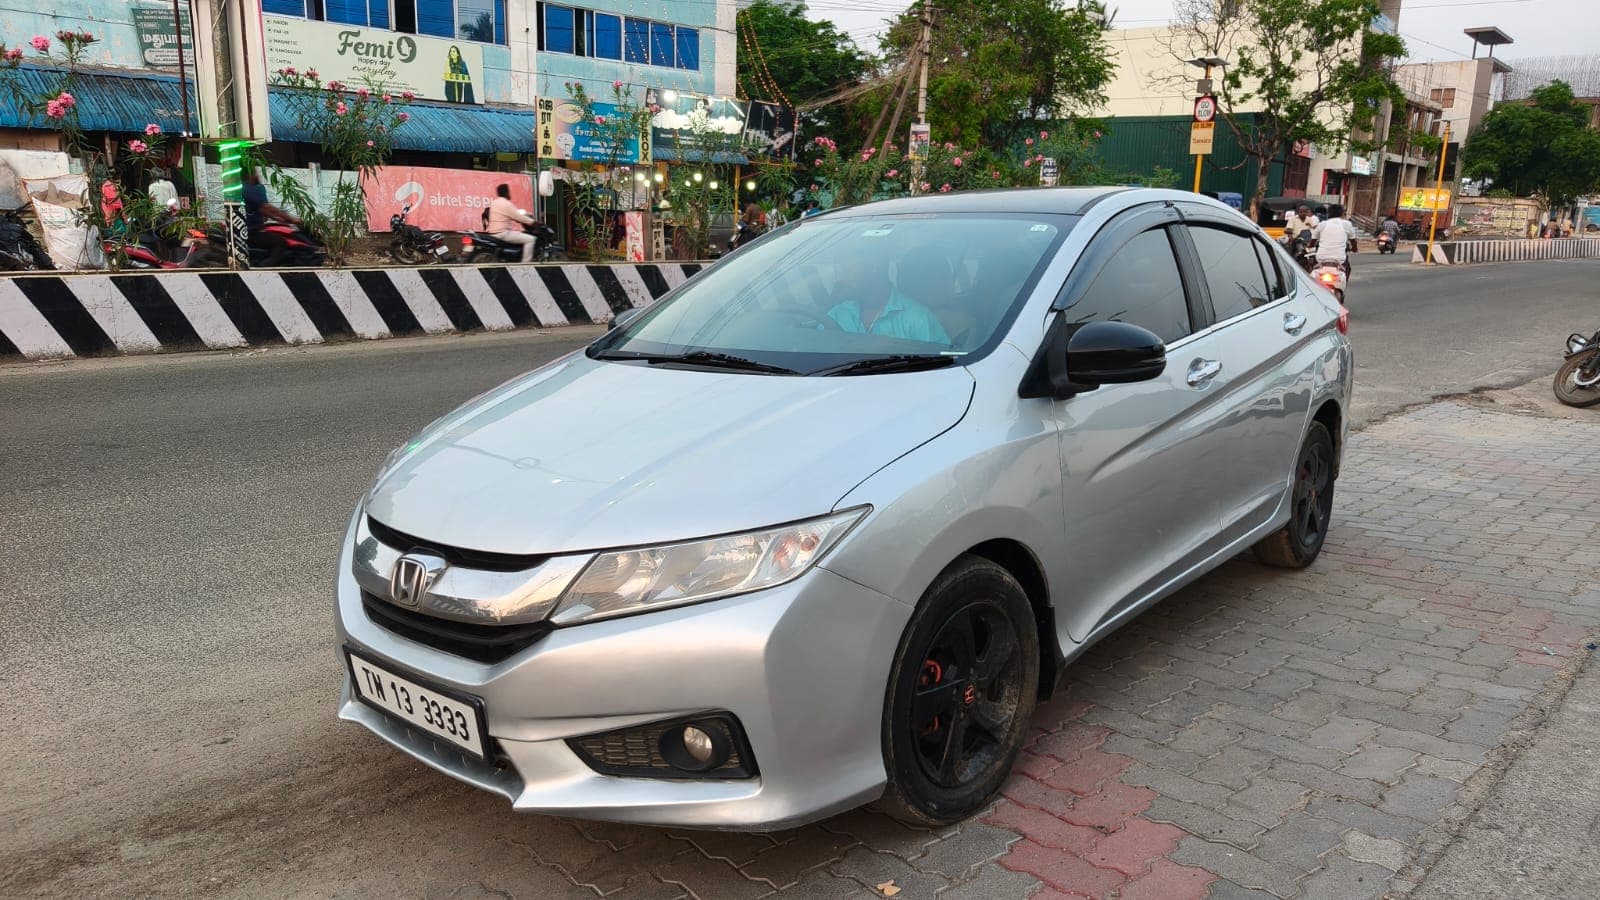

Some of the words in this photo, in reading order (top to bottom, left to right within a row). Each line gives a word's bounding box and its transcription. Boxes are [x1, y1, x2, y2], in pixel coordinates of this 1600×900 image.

[337, 30, 395, 59] Femi
[358, 56, 378, 66] Happy
[352, 66, 397, 80] everyday
[1198, 110, 1212, 118] SLOW
[640, 111, 650, 162] EROX
[430, 193, 462, 206] airtel
[362, 667, 386, 702] TN
[391, 682, 414, 714] 13
[420, 695, 470, 740] 3333
